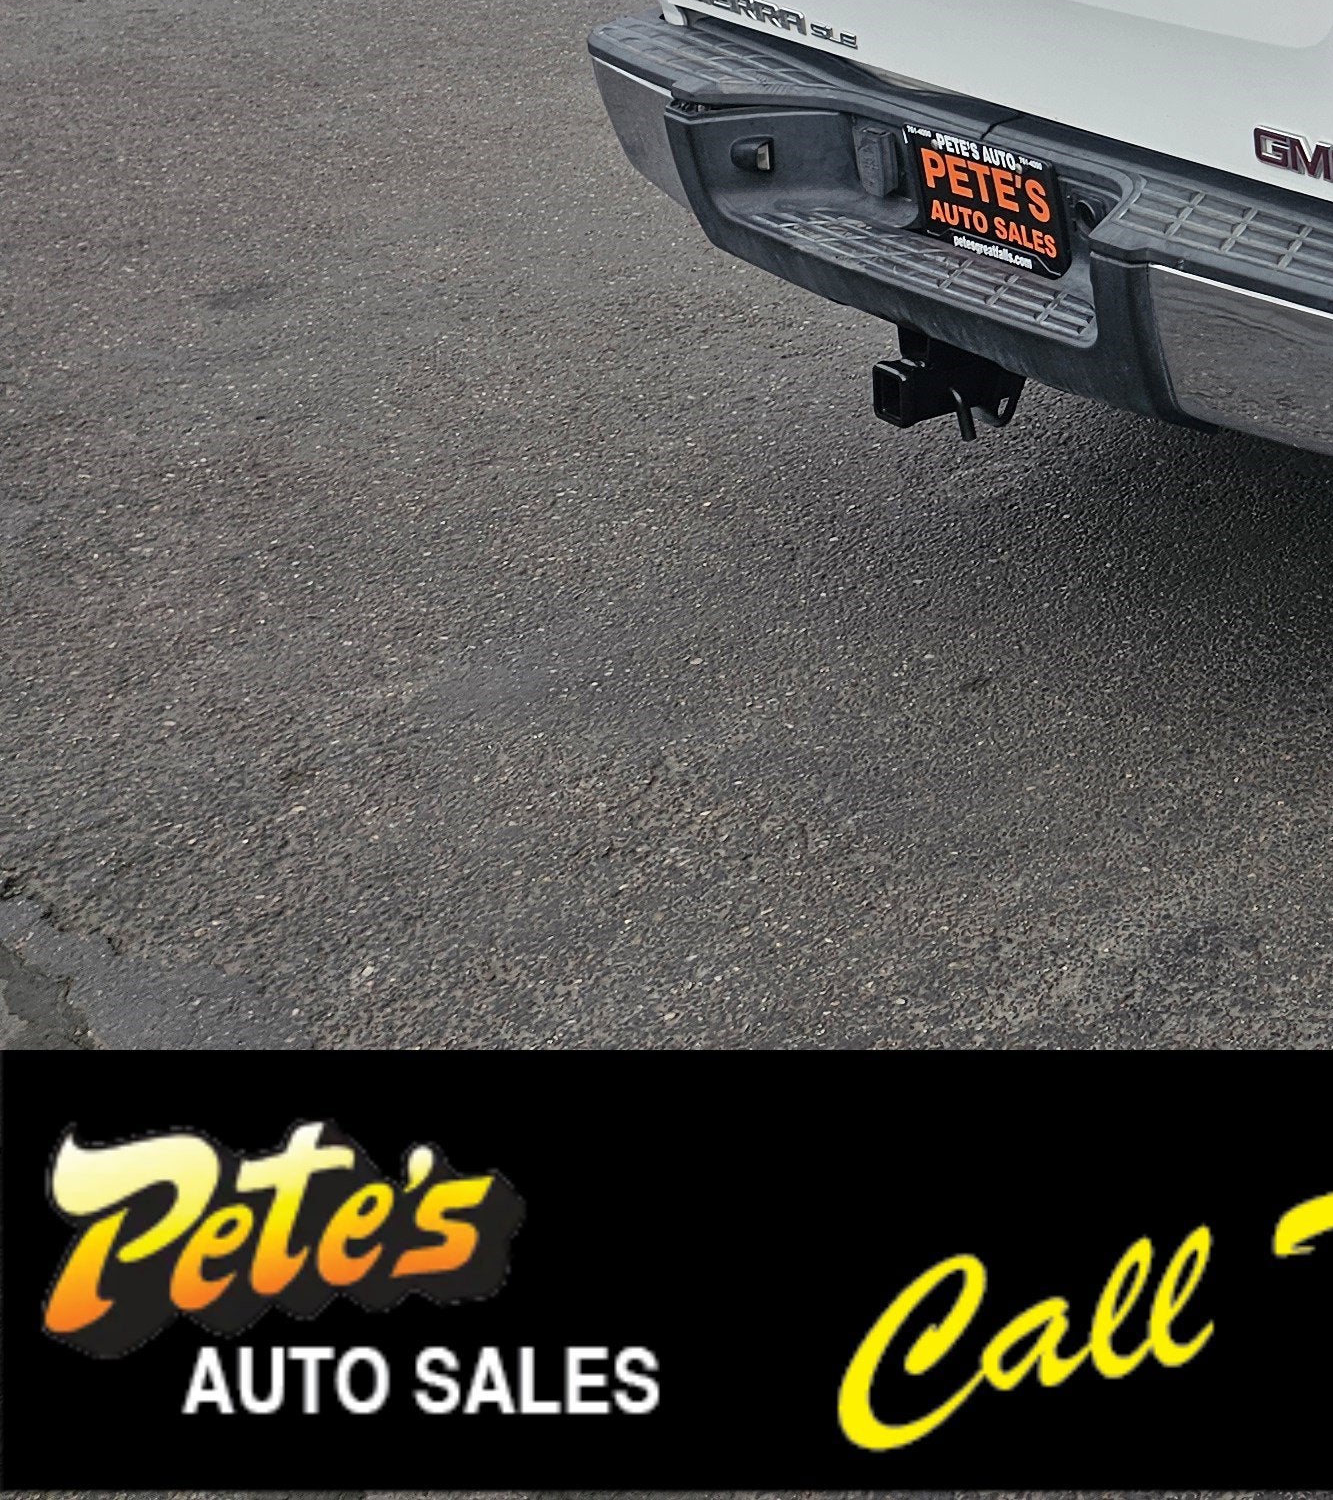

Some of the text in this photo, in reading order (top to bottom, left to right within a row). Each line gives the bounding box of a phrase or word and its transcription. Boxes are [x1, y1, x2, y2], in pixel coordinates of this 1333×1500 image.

[810, 22, 859, 50] SLE
[935, 132, 980, 161] PETE'S
[983, 146, 1016, 171] AUTO
[921, 147, 1051, 223] PETE'S
[931, 200, 1057, 258] AUTO SALES
[953, 235, 1033, 270] petesgreatfalls.com
